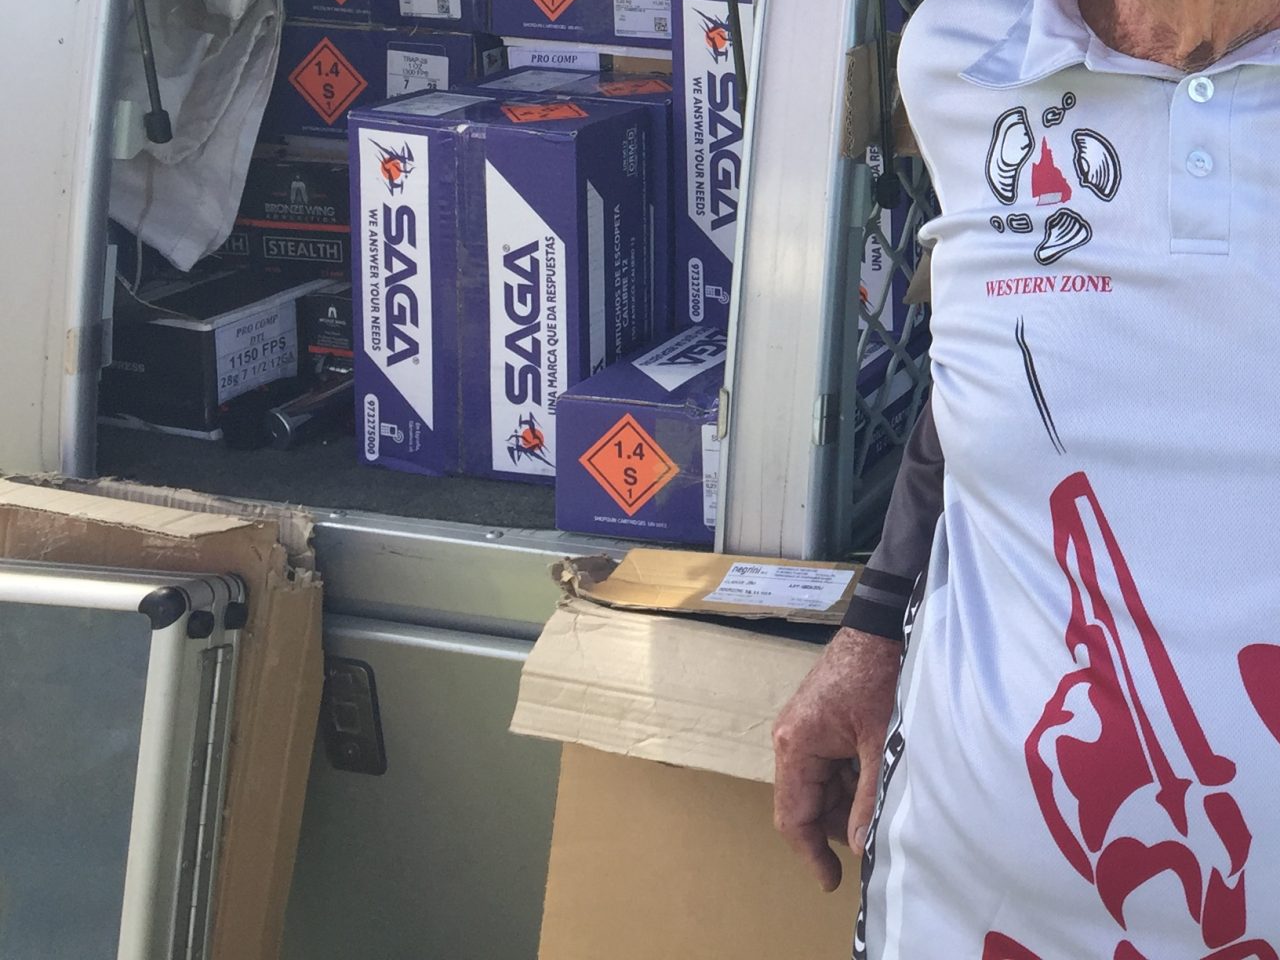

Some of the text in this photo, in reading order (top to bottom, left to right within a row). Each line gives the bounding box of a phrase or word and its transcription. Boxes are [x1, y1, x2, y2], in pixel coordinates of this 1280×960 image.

[314, 60, 340, 77] 1.4
[531, 54, 578, 64] PRO COMP
[322, 83, 335, 100] S
[403, 79, 409, 89] 7
[326, 102, 332, 110] 1
[693, 76, 705, 216] WE ANSWER YOUR NEEDS
[707, 70, 743, 232] SAGA
[269, 240, 338, 259] STEALTH
[871, 247, 882, 271] UNA
[545, 236, 556, 303] RESPUESTAS
[622, 258, 628, 273] 12
[369, 208, 381, 351] WE ANSWER YOUR NEEDS
[383, 202, 420, 367] SAGA
[615, 269, 621, 287] DE
[986, 275, 1113, 297] WESTERN ZONE
[547, 305, 557, 321] DA
[503, 240, 542, 407] SAGA
[547, 323, 558, 347] QUE
[230, 336, 286, 368] 1150 FPS
[242, 369, 248, 380] 7
[548, 349, 558, 388] MARCA
[367, 400, 376, 455] 973275000
[614, 440, 645, 461] 1.4
[623, 466, 638, 486] S
[627, 488, 633, 499] 1
[732, 565, 761, 576] negrini
